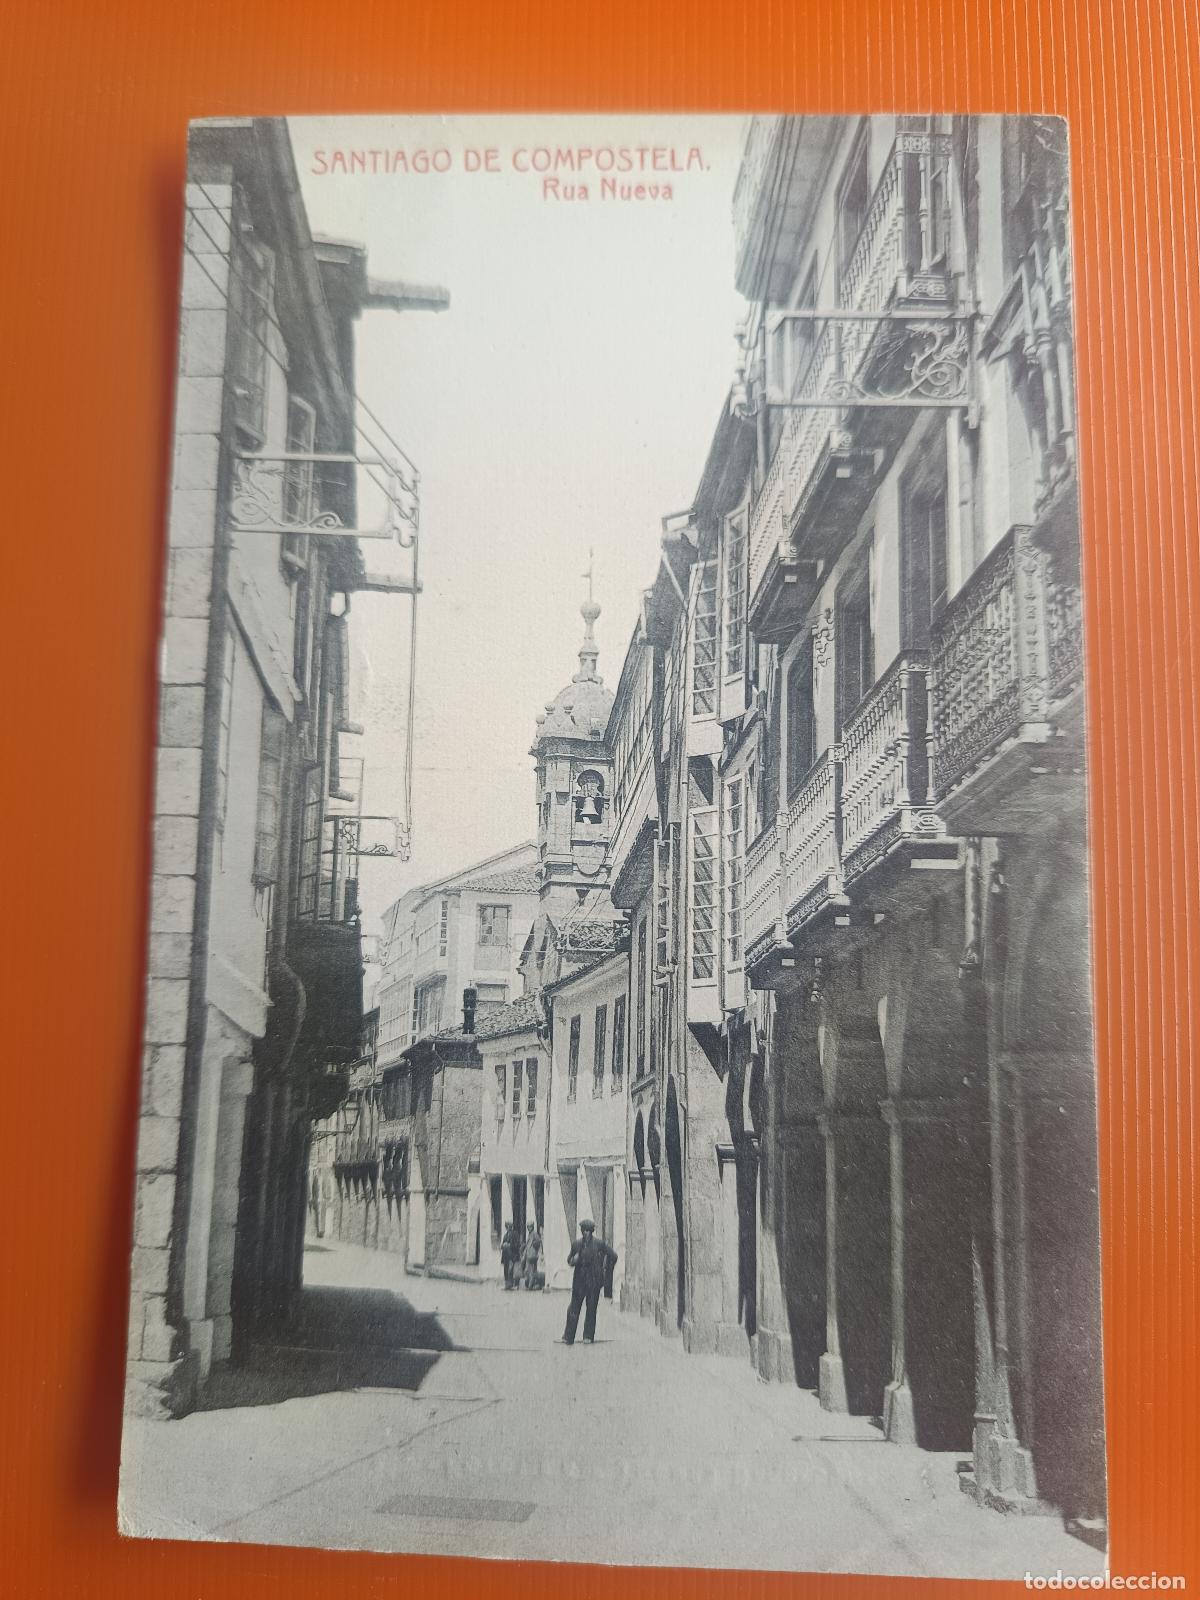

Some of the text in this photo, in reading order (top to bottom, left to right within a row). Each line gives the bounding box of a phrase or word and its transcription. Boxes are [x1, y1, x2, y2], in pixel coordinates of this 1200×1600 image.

[311, 147, 711, 175] SANTIAGO DE COMPOSTELA.
[542, 177, 674, 201] Rua Nueva
